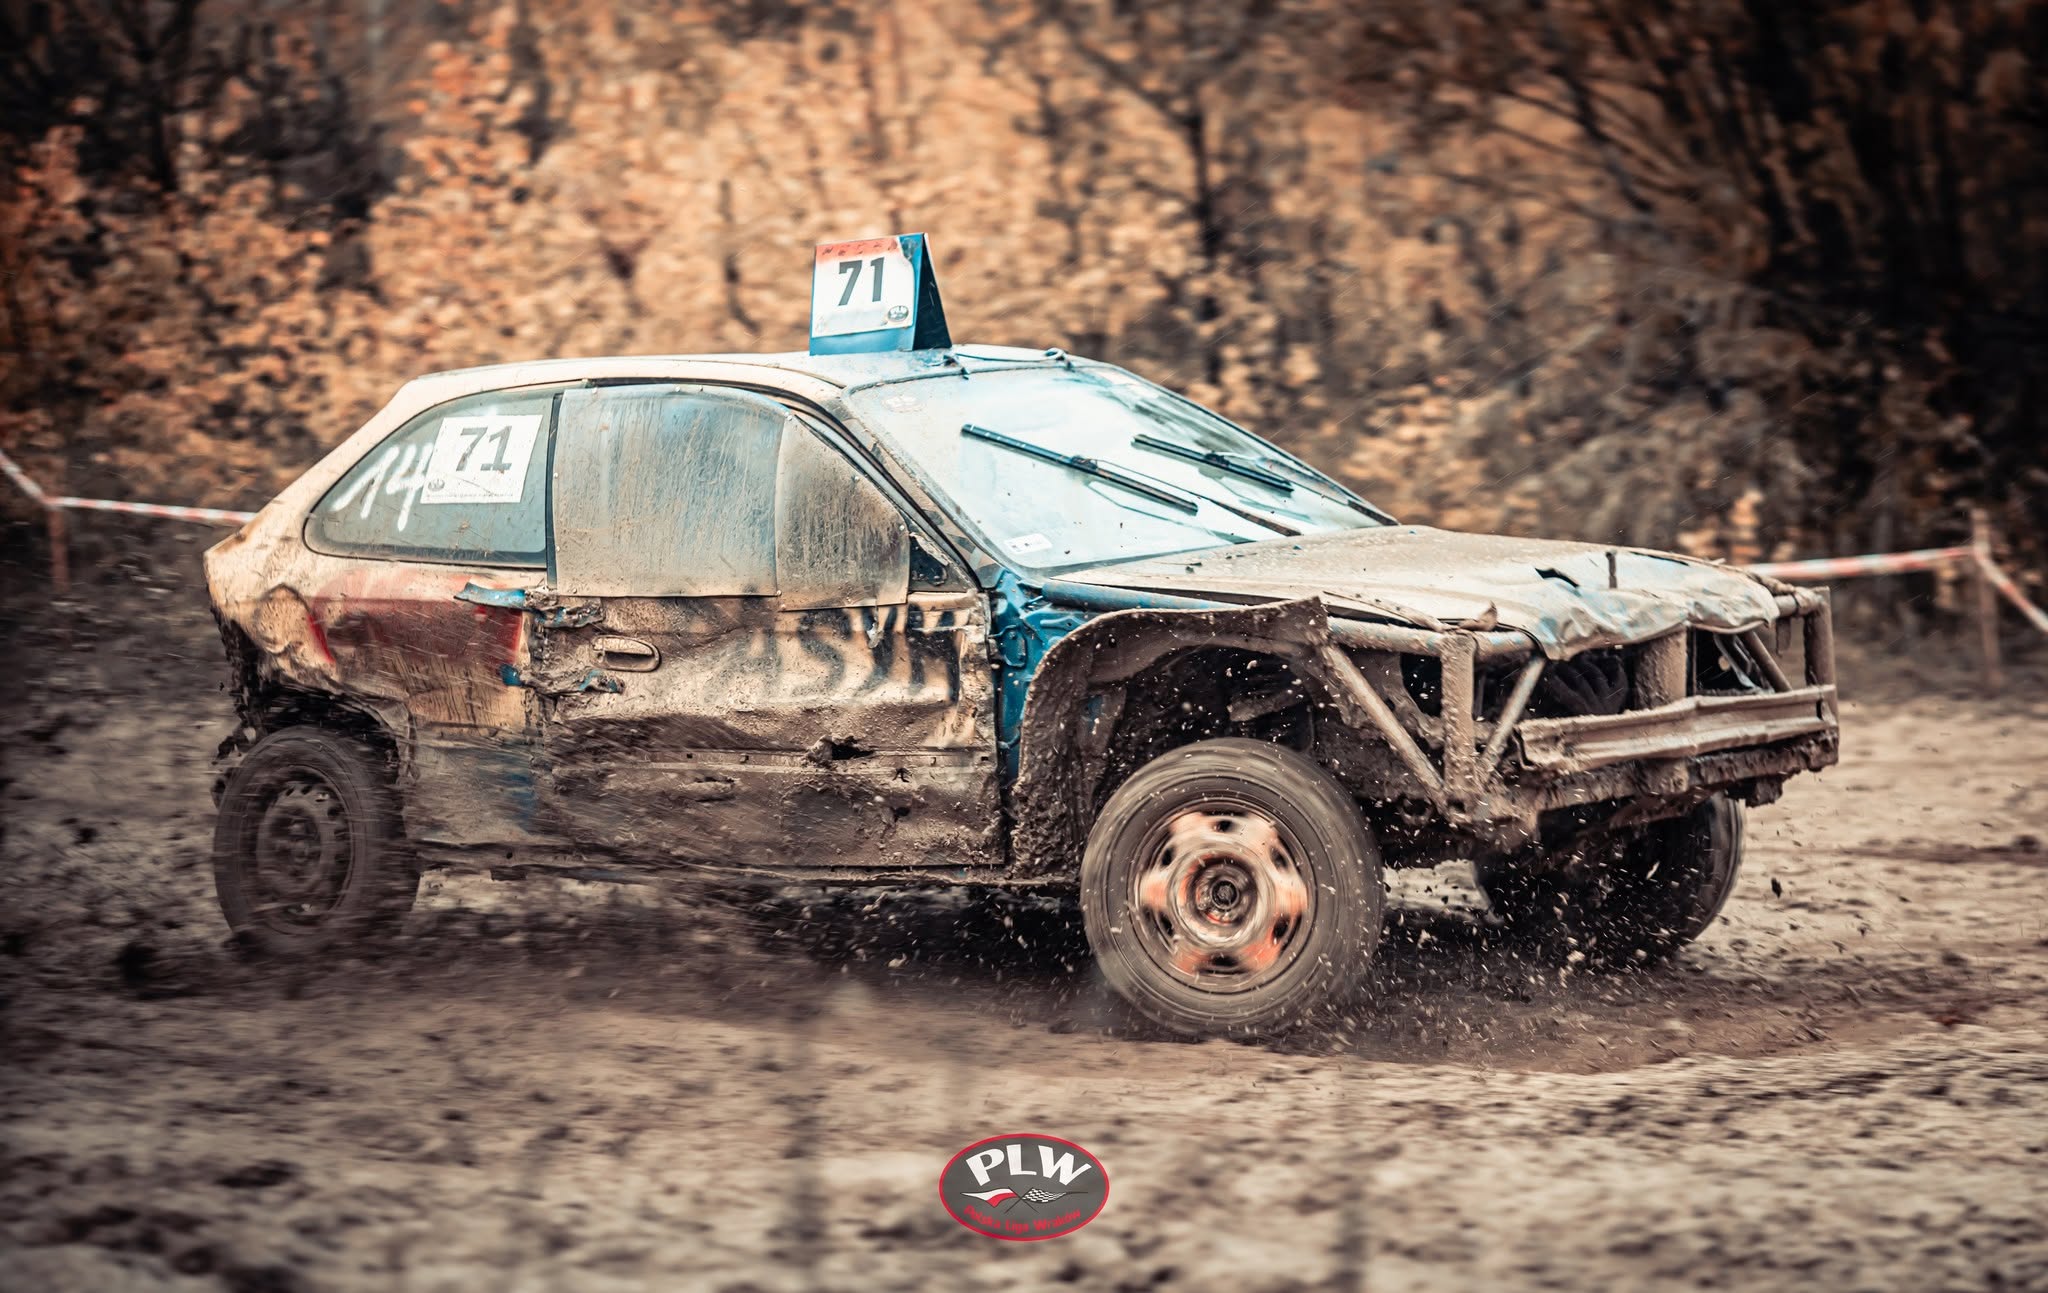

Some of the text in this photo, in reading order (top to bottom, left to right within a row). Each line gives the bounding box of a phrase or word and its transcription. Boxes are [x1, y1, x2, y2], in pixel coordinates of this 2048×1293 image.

[838, 256, 885, 306] 71
[455, 425, 512, 472] 71
[330, 442, 434, 532] 14
